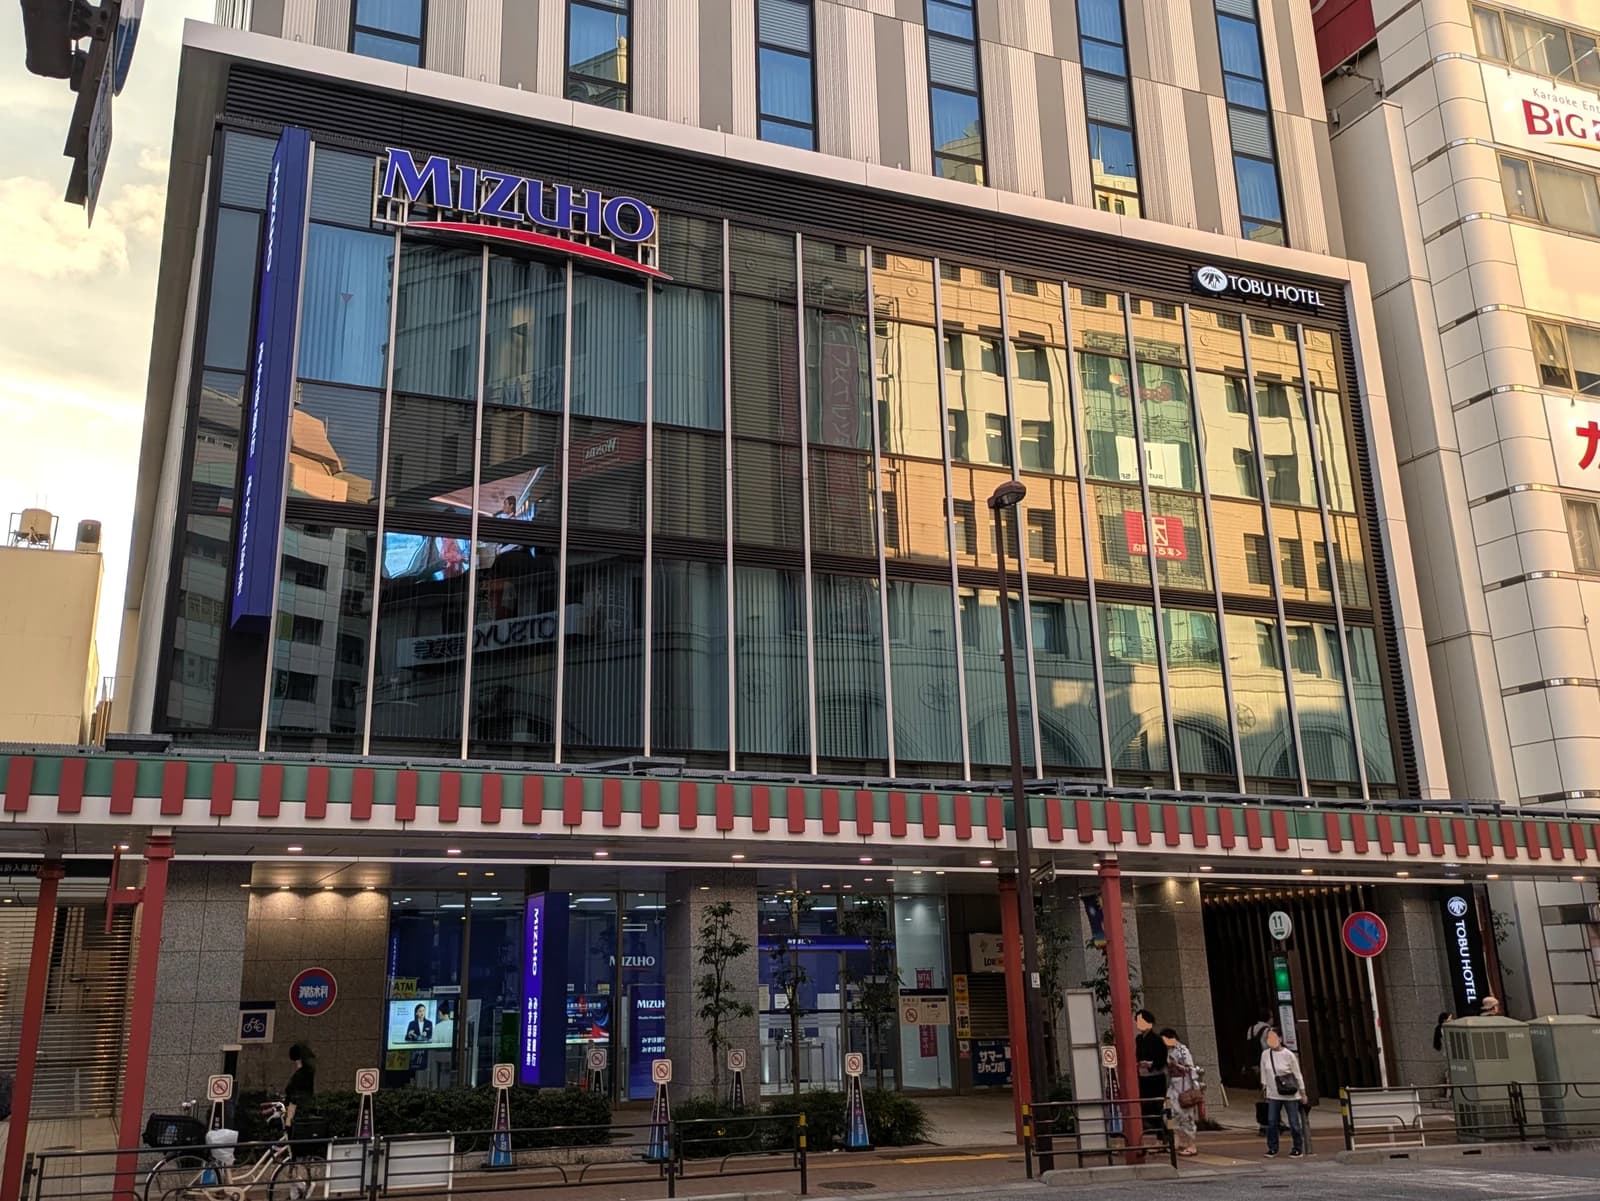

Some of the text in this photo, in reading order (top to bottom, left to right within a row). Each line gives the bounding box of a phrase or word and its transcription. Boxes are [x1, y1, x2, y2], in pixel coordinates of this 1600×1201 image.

[1533, 88, 1578, 107] Karaoke
[382, 147, 655, 241] MIZUHO
[1228, 275, 1325, 306] TOBU HOTEL
[1272, 915, 1283, 928] 11
[531, 908, 540, 976] MIZUHO
[609, 956, 656, 967] MIZUHO
[1455, 920, 1477, 1004] TOBU HOTEL
[394, 982, 414, 992] ATM
[637, 999, 665, 1009] MIZUH
